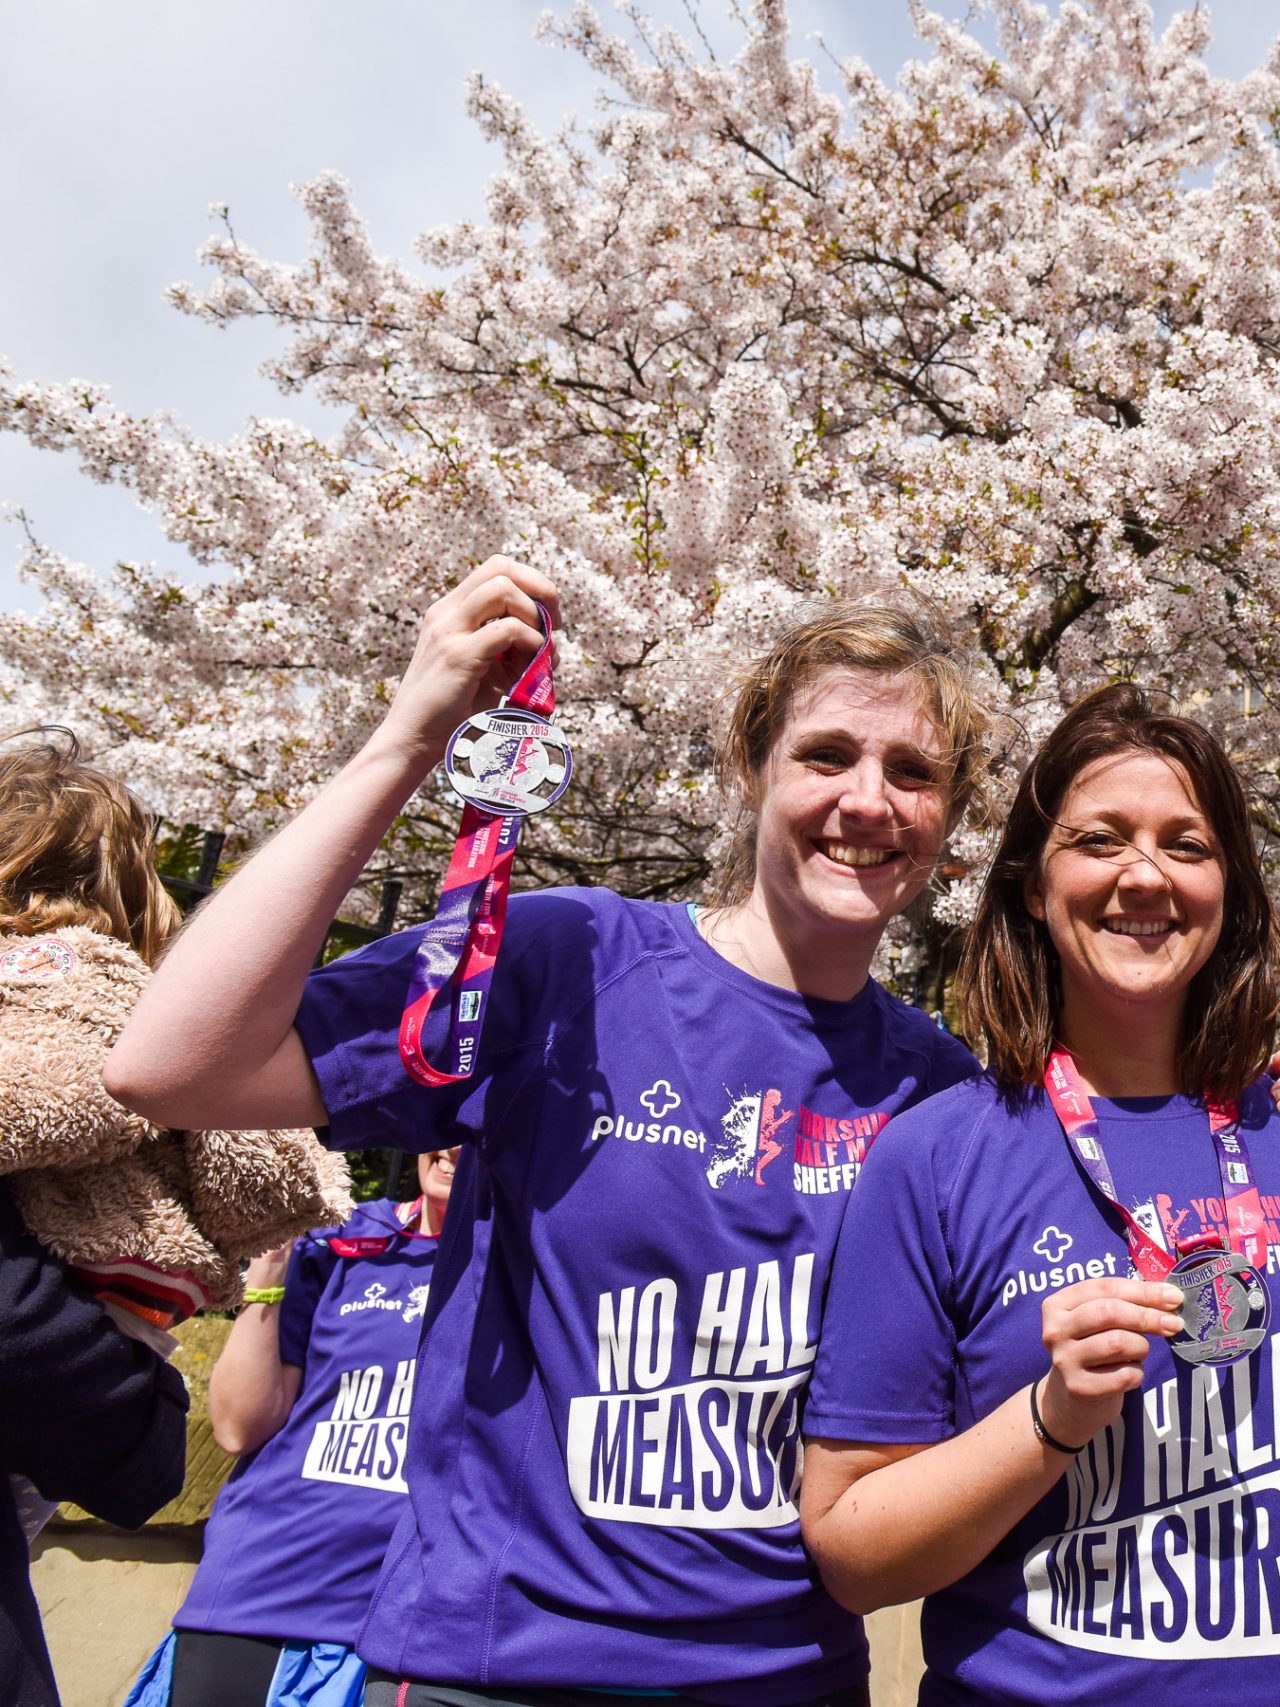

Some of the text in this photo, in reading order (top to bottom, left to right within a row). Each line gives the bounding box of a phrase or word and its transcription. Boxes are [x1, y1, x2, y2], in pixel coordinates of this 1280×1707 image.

[487, 719, 549, 737] FINISHER 2015
[458, 1037, 474, 1073] 2015
[591, 1114, 707, 1154] plusnet
[794, 1133, 838, 1168] HALF
[1218, 1133, 1241, 1154] 2015
[793, 1161, 862, 1195] SHEFF
[1002, 1252, 1117, 1307] plusnet
[1178, 1257, 1232, 1289] FINISHER 2015
[339, 1298, 403, 1317] plusnet
[597, 1252, 819, 1393] NO HAL
[330, 1364, 384, 1422] NO
[318, 1421, 407, 1481] MEAS
[588, 1382, 803, 1513] MEASUR
